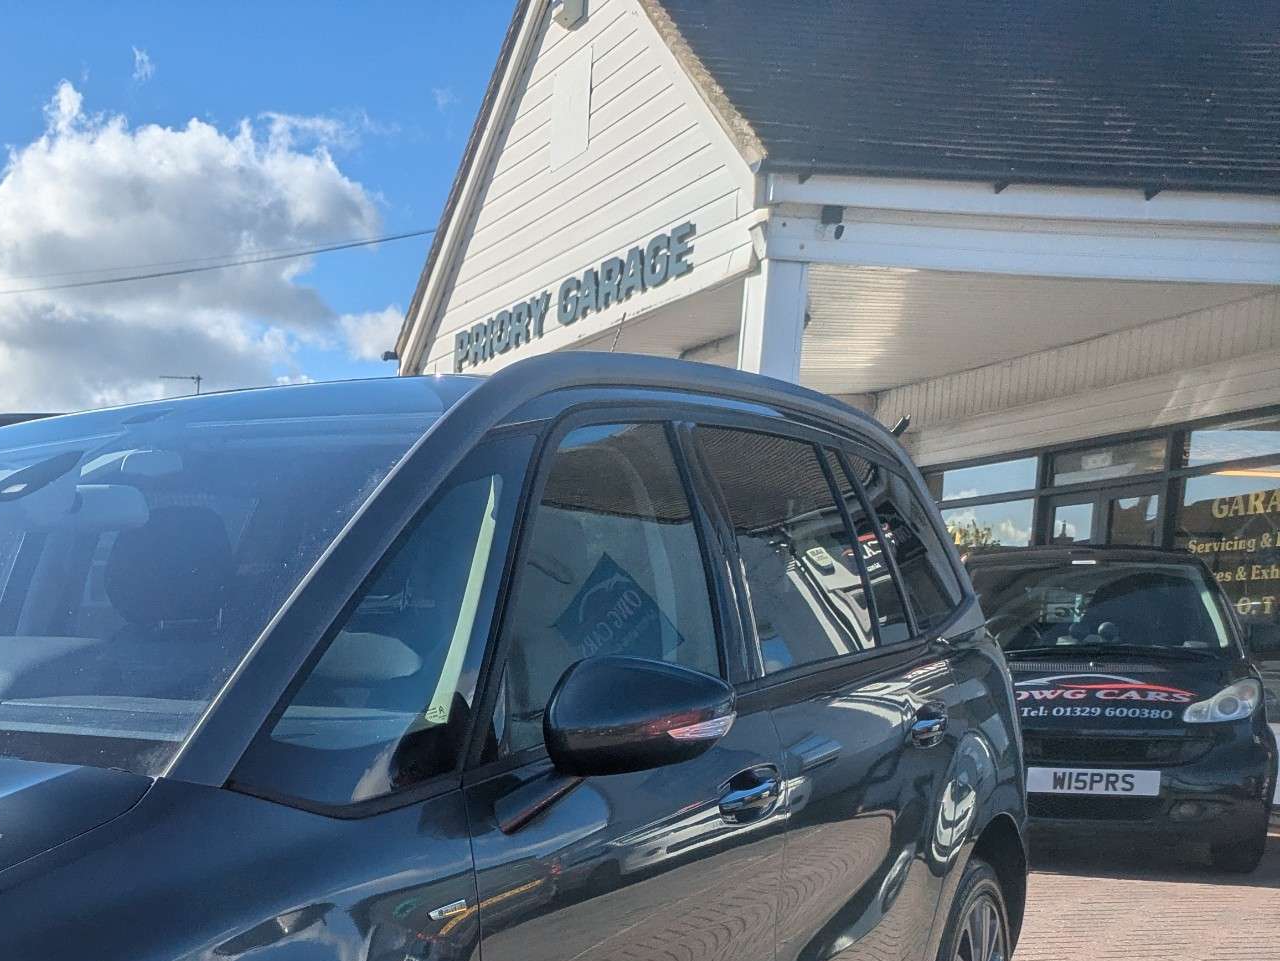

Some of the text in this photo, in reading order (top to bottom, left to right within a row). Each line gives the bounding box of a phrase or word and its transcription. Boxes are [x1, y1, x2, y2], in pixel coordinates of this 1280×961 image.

[453, 220, 697, 374] PRIORY GARAGE
[1187, 536, 1257, 553] Servicing
[1260, 532, 1272, 548] &
[1235, 566, 1247, 581] &
[1095, 689, 1192, 703] CARS
[1021, 705, 1173, 720] Tel: 01329 600380
